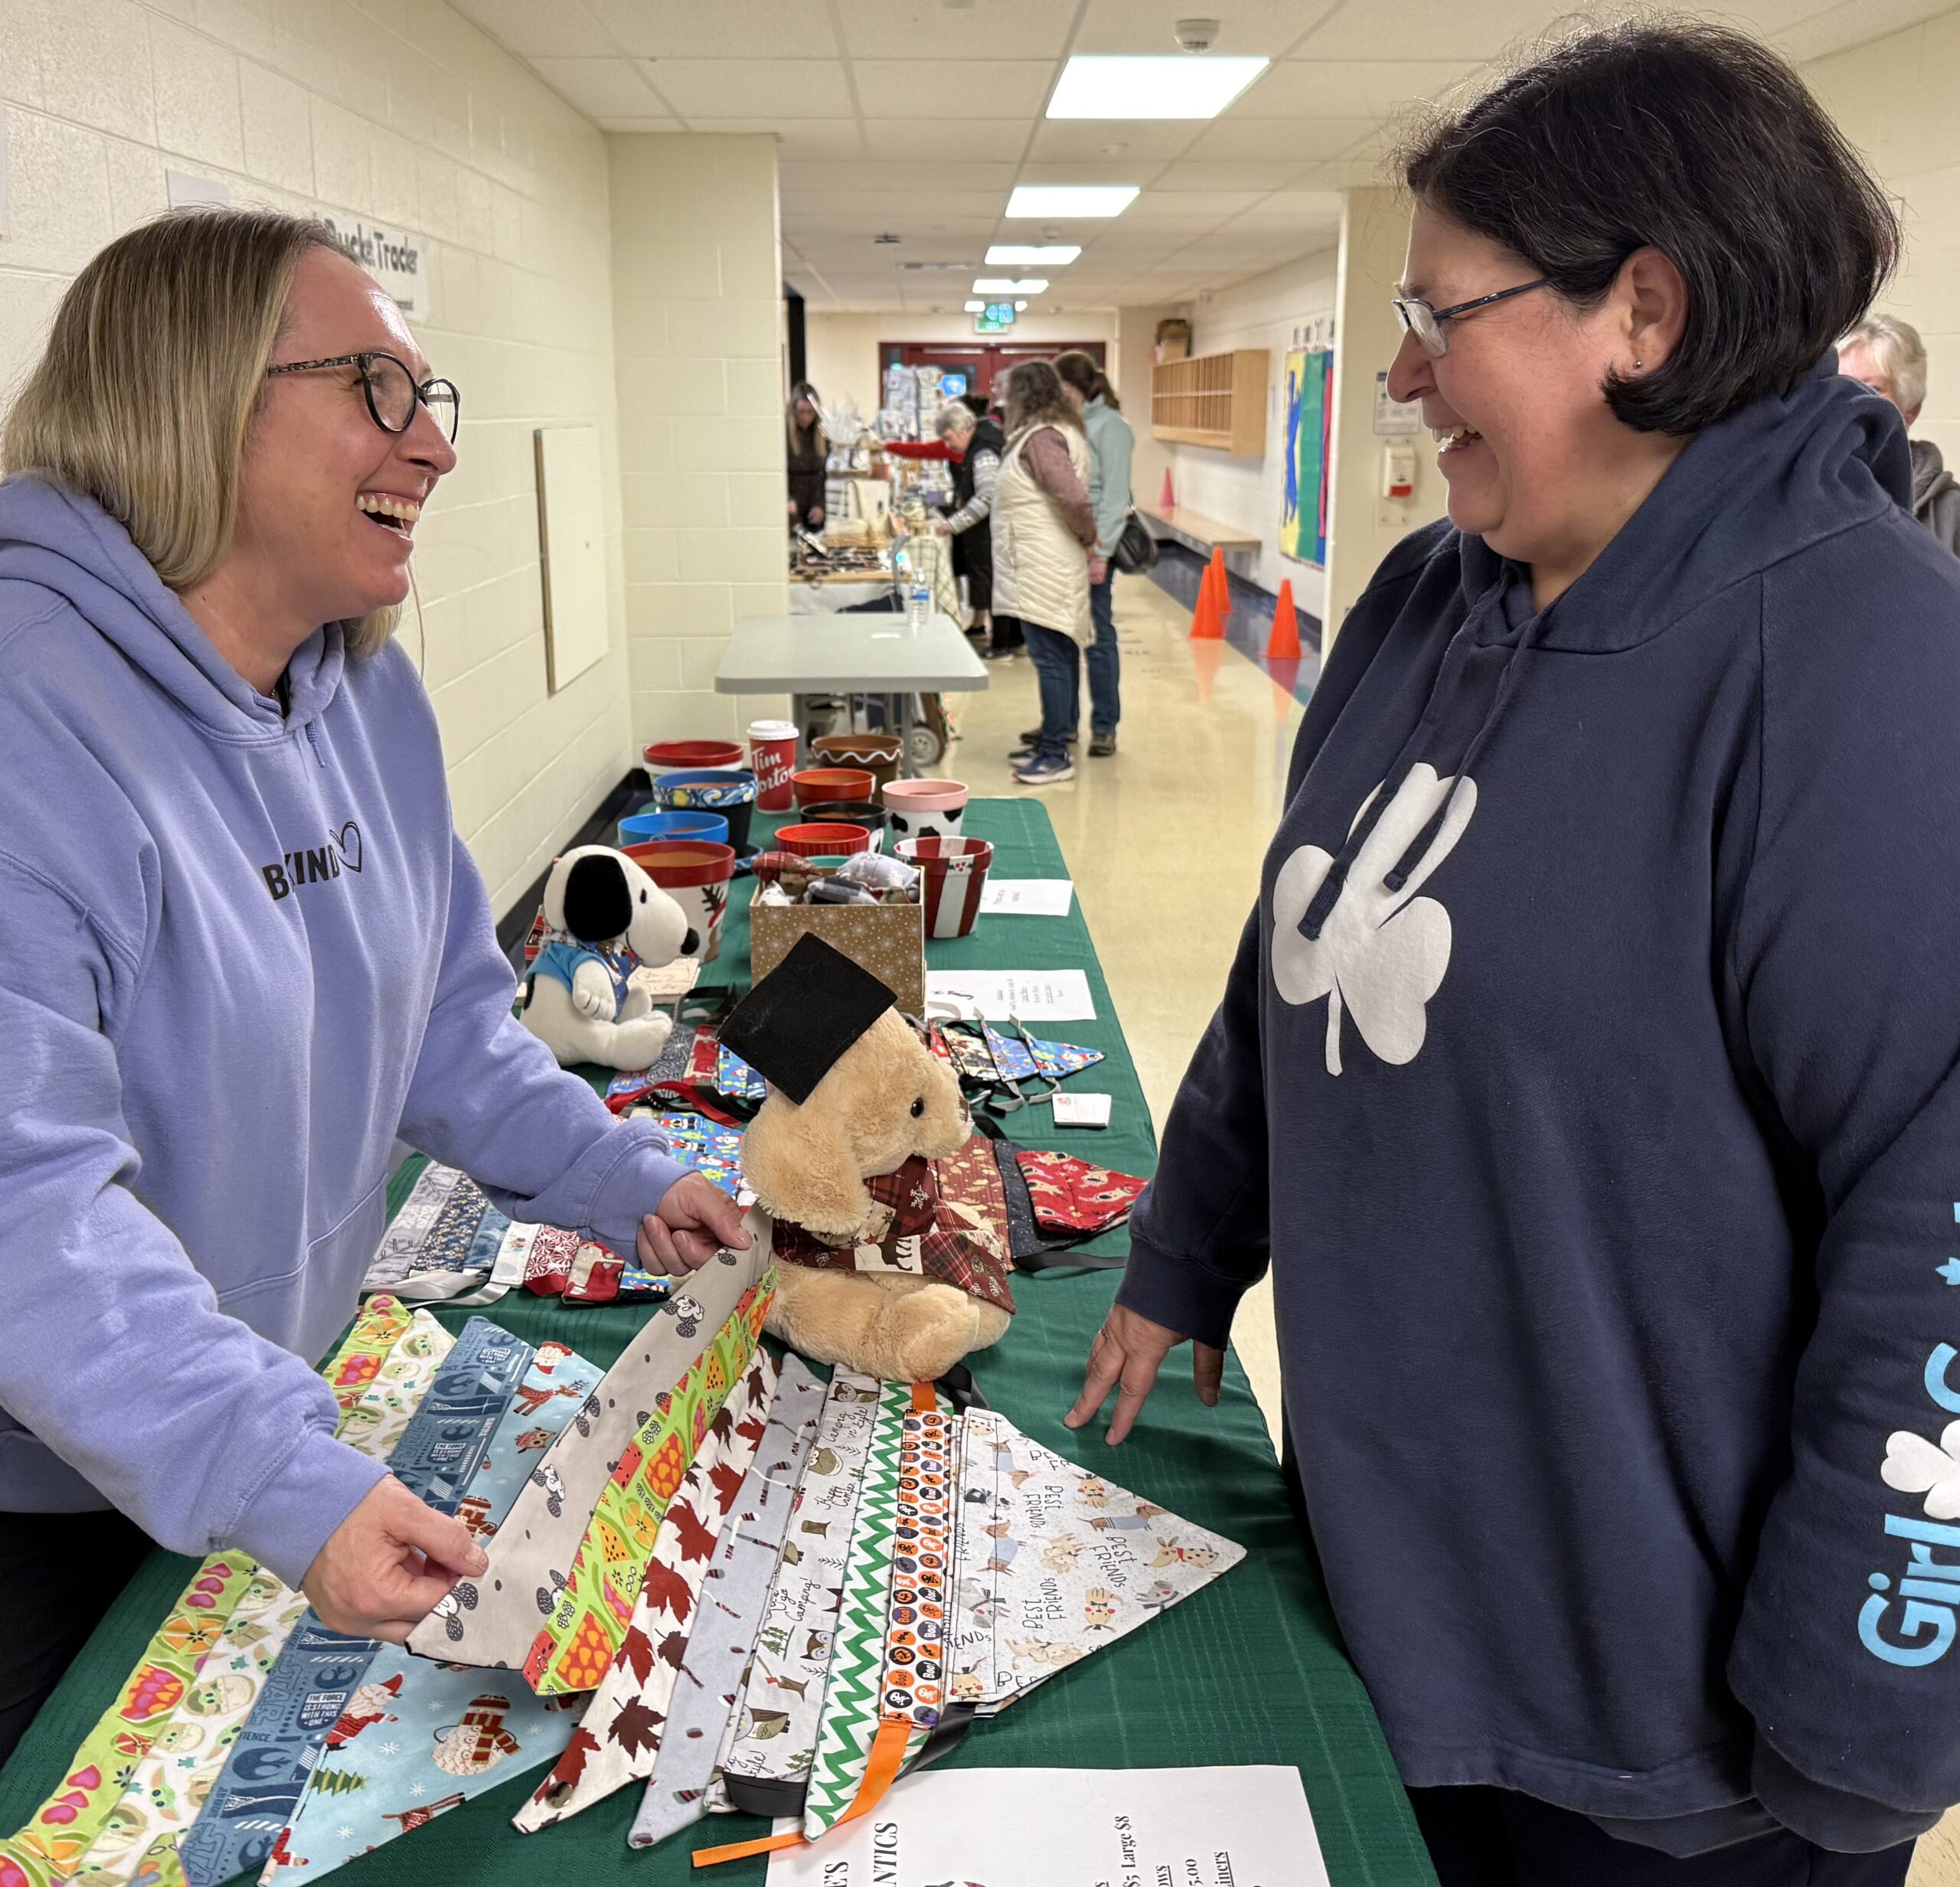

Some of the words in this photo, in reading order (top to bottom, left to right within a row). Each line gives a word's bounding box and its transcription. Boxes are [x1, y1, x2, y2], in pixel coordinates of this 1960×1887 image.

[752, 746, 782, 772] Tim
[758, 763, 795, 793] orton
[284, 844, 340, 886] KIND
[1044, 1484, 1064, 1510] BEST
[1106, 1536, 1137, 1564] BEST
[1857, 1513, 1960, 1667] Girl
[897, 1608, 911, 1624] Boo!
[1021, 1598, 1044, 1629] BEST
[923, 1621, 938, 1638] Boo!
[895, 1670, 907, 1686] Boo!
[923, 1662, 936, 1679] Boo!
[1113, 1815, 1132, 1830] $8
[873, 1823, 898, 1887] NTICS
[1119, 1833, 1137, 1869] Large
